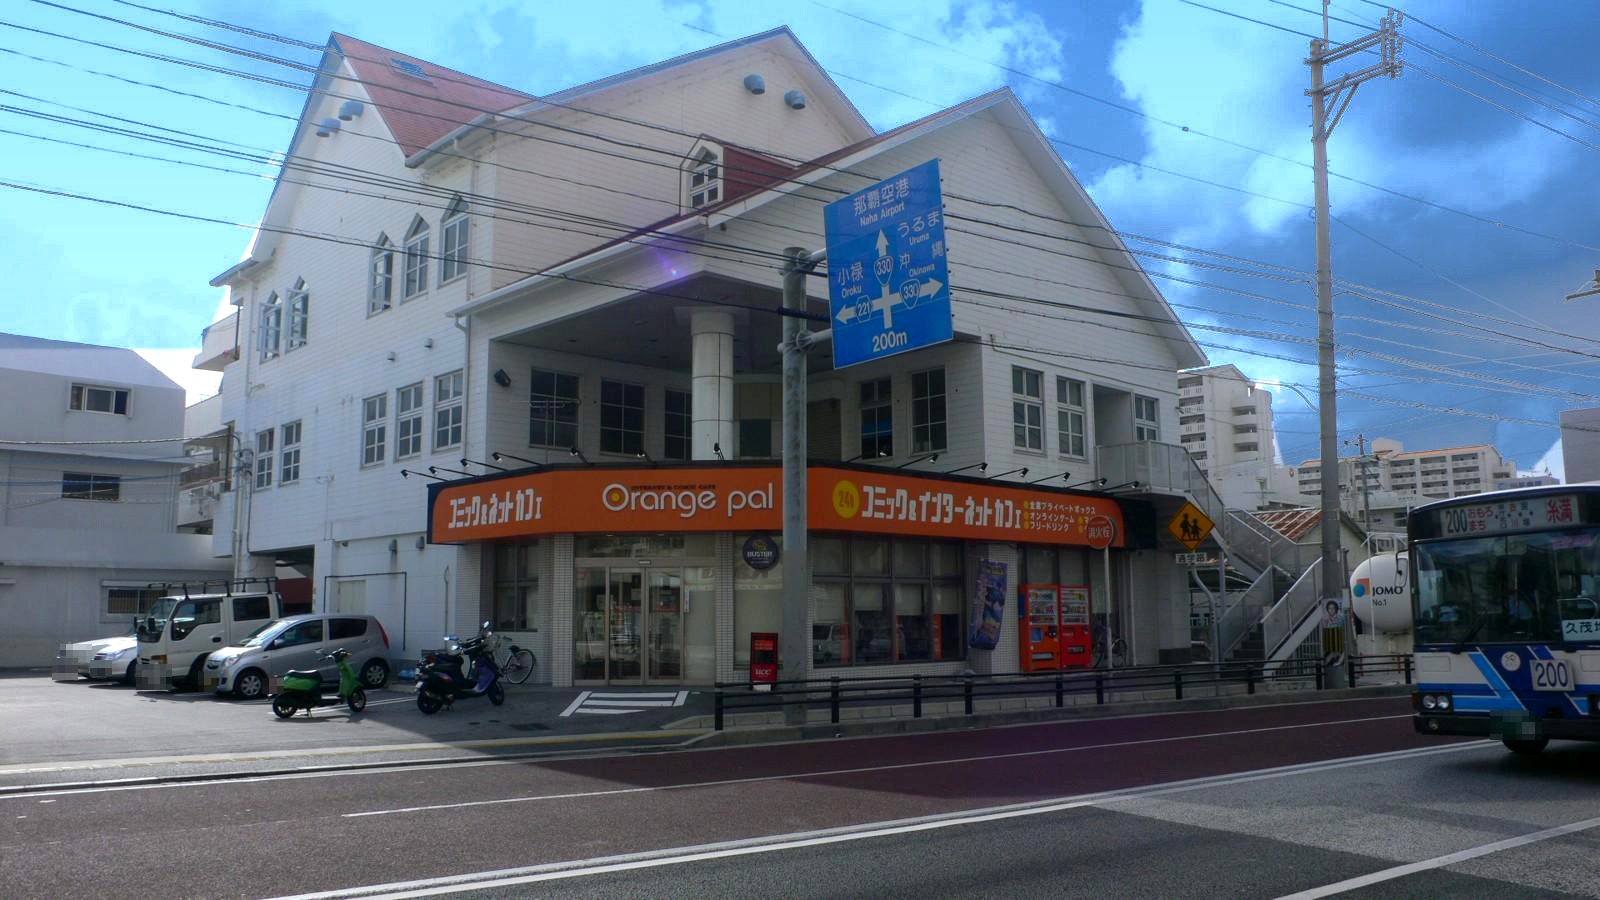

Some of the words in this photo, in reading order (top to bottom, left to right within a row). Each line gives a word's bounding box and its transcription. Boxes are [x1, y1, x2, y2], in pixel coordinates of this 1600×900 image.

[854, 178, 910, 216] 那覇空港
[860, 214, 878, 226] Naha
[881, 202, 905, 219] Airport
[898, 211, 940, 237] うるま
[909, 233, 930, 246] Uruma
[838, 261, 864, 286] 小禄
[876, 258, 891, 275] 330
[909, 263, 936, 278] Okinawa
[841, 285, 863, 299] Oroku
[903, 283, 919, 301] 330
[857, 303, 870, 317] 221
[872, 331, 908, 353] 200m
[602, 483, 717, 518] Orange
[727, 482, 774, 517] pal
[1445, 509, 1467, 533] 200
[1372, 586, 1404, 597] JOMO
[1372, 599, 1387, 607] No.1
[1535, 662, 1569, 688] 200
